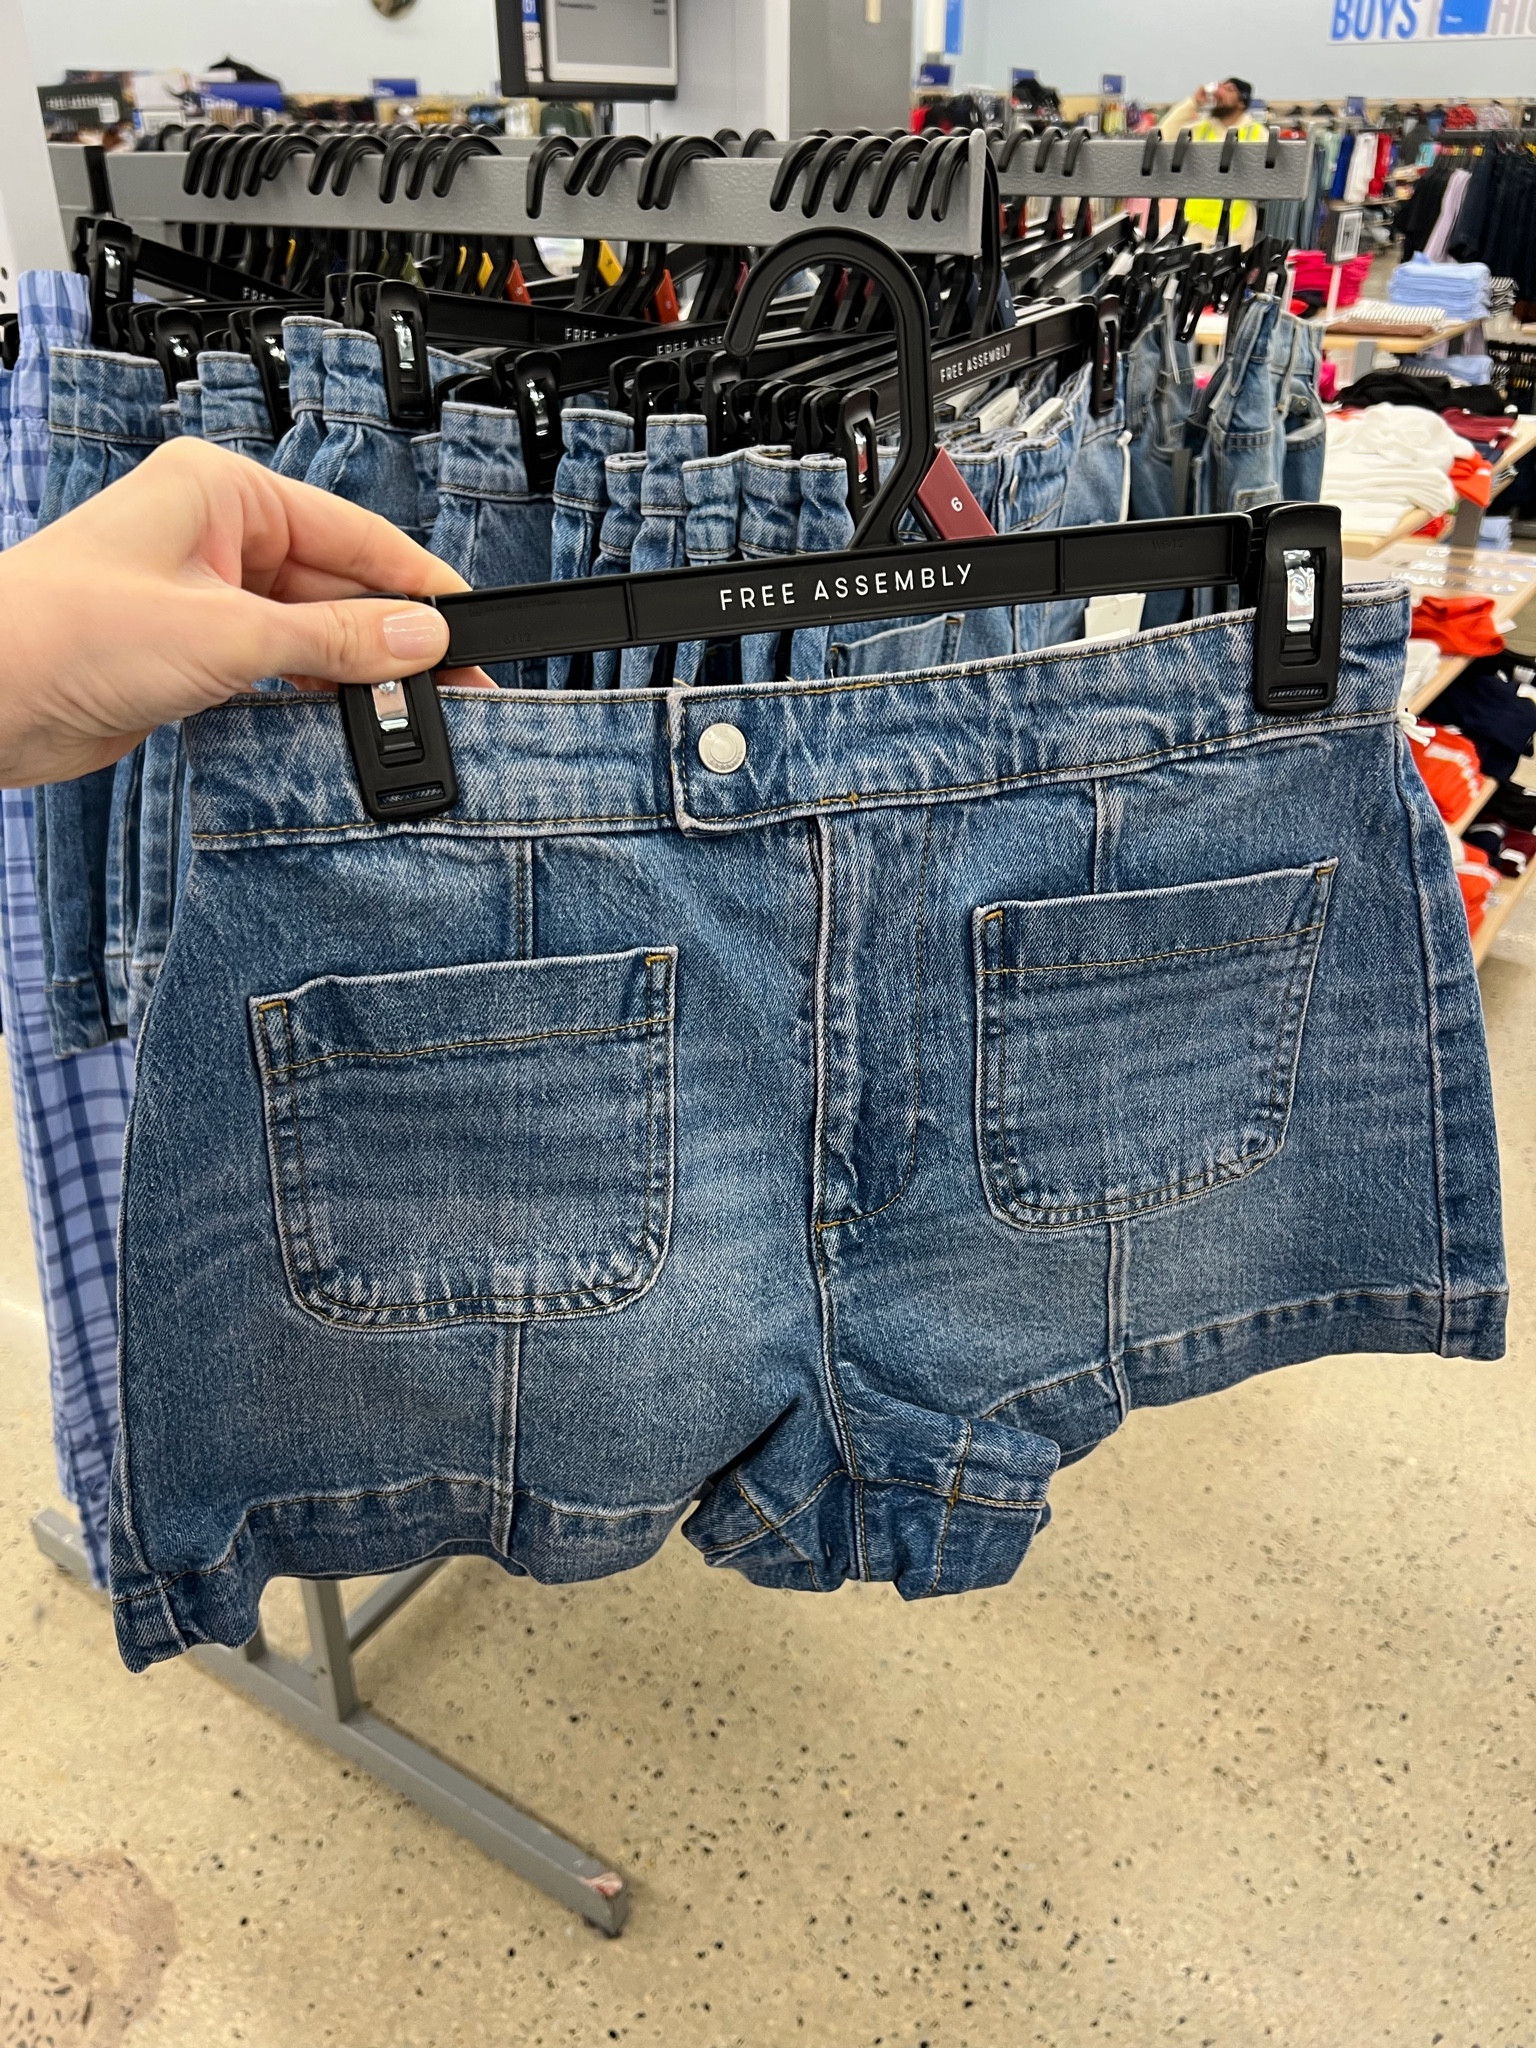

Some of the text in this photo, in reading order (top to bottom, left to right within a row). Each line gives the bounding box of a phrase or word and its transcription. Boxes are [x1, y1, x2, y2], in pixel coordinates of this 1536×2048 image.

[1331, 0, 1419, 41] BOYS
[940, 343, 1012, 383] FREE ASSEMBLY
[951, 496, 963, 512] 6
[719, 563, 972, 611] FREE ASSEMBLY
